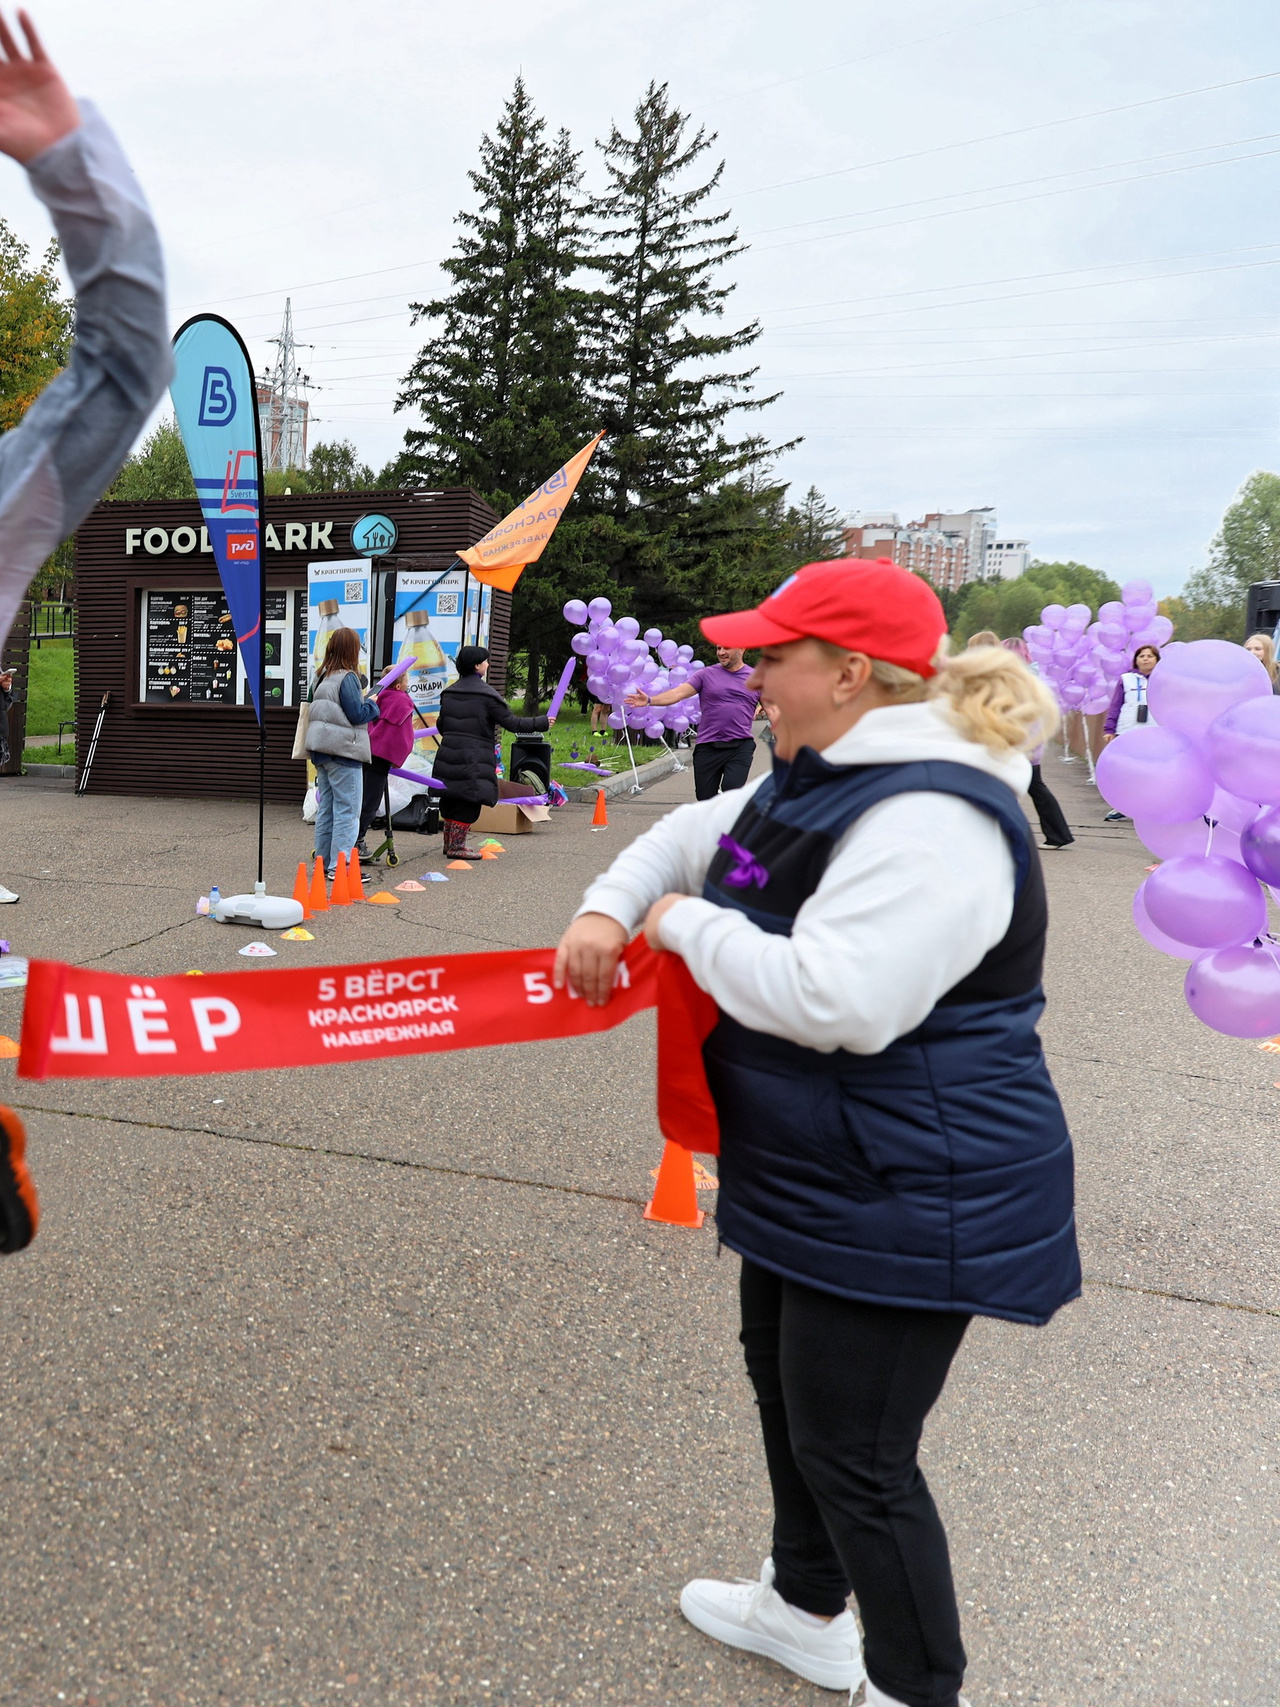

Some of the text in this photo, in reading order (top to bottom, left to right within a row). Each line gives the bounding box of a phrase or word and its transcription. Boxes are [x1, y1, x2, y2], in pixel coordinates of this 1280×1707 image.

[265, 521, 334, 550] ARK
[318, 968, 446, 1002] 5 ВЁРСТ
[523, 971, 553, 1004] 5
[308, 995, 459, 1028] КРАСНОЯРСК
[322, 1019, 456, 1048] НАБЕРЕЖНАЯ
